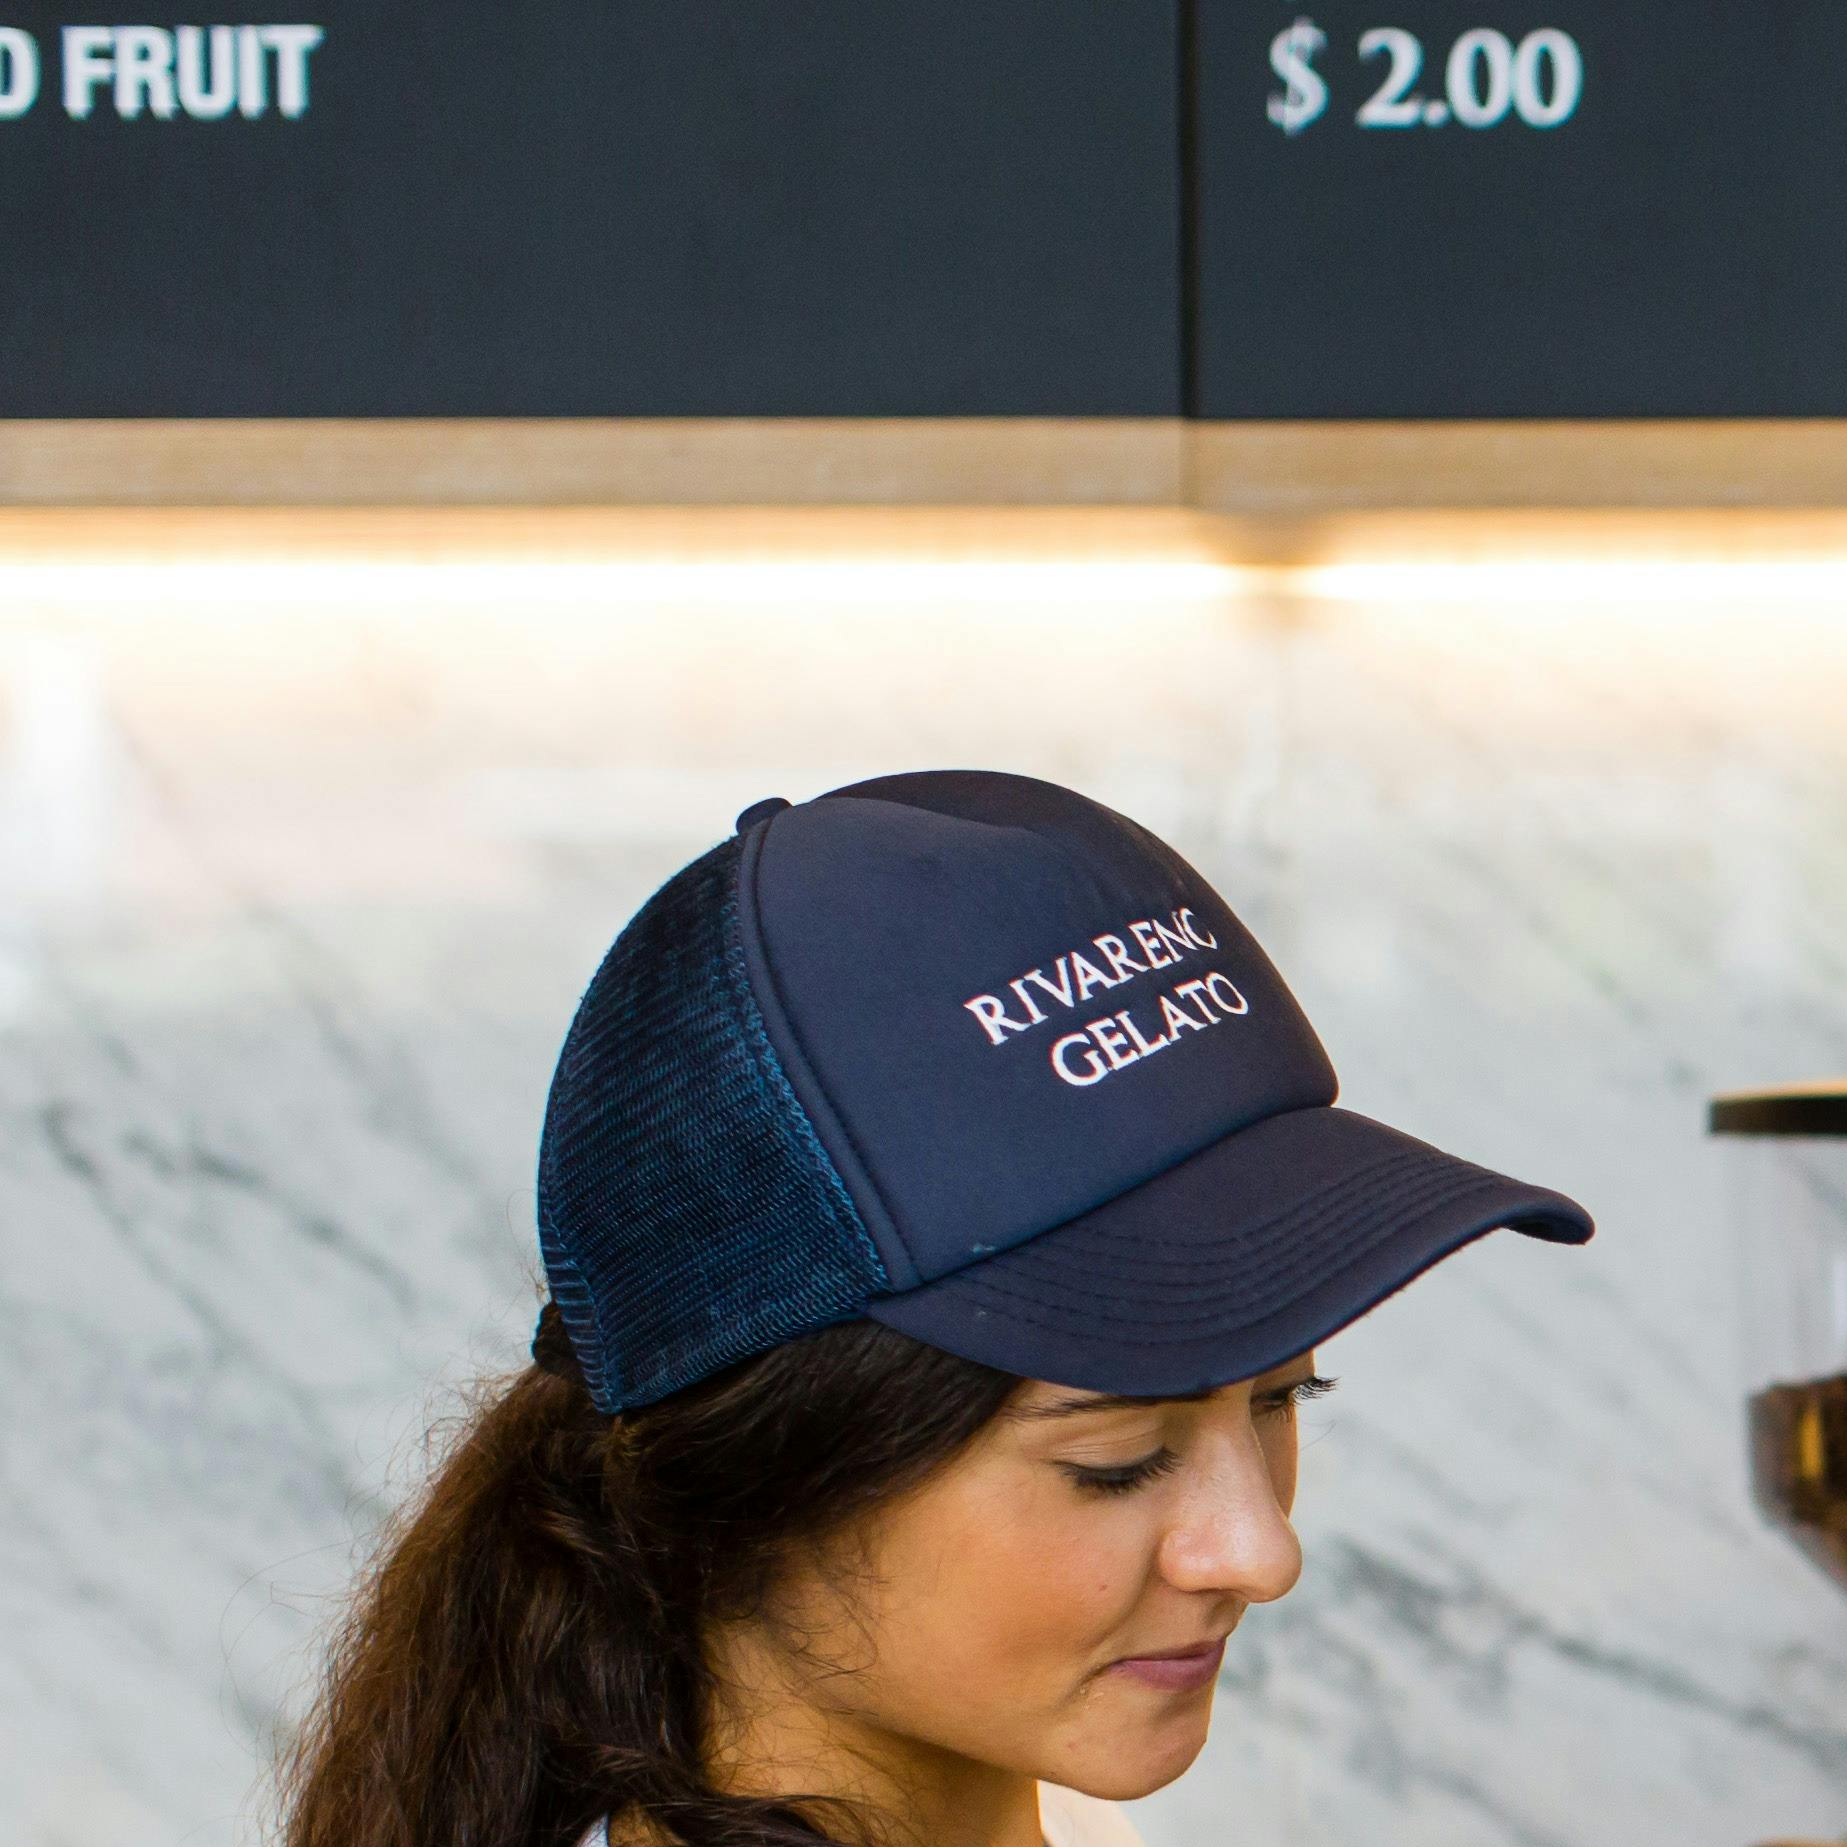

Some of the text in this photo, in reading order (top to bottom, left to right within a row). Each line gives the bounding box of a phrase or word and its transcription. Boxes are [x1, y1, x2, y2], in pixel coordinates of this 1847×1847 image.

[61, 24, 328, 121] FRUIT
[1266, 15, 1585, 138] $ 2.00
[1049, 970, 1249, 1087] GELATO
